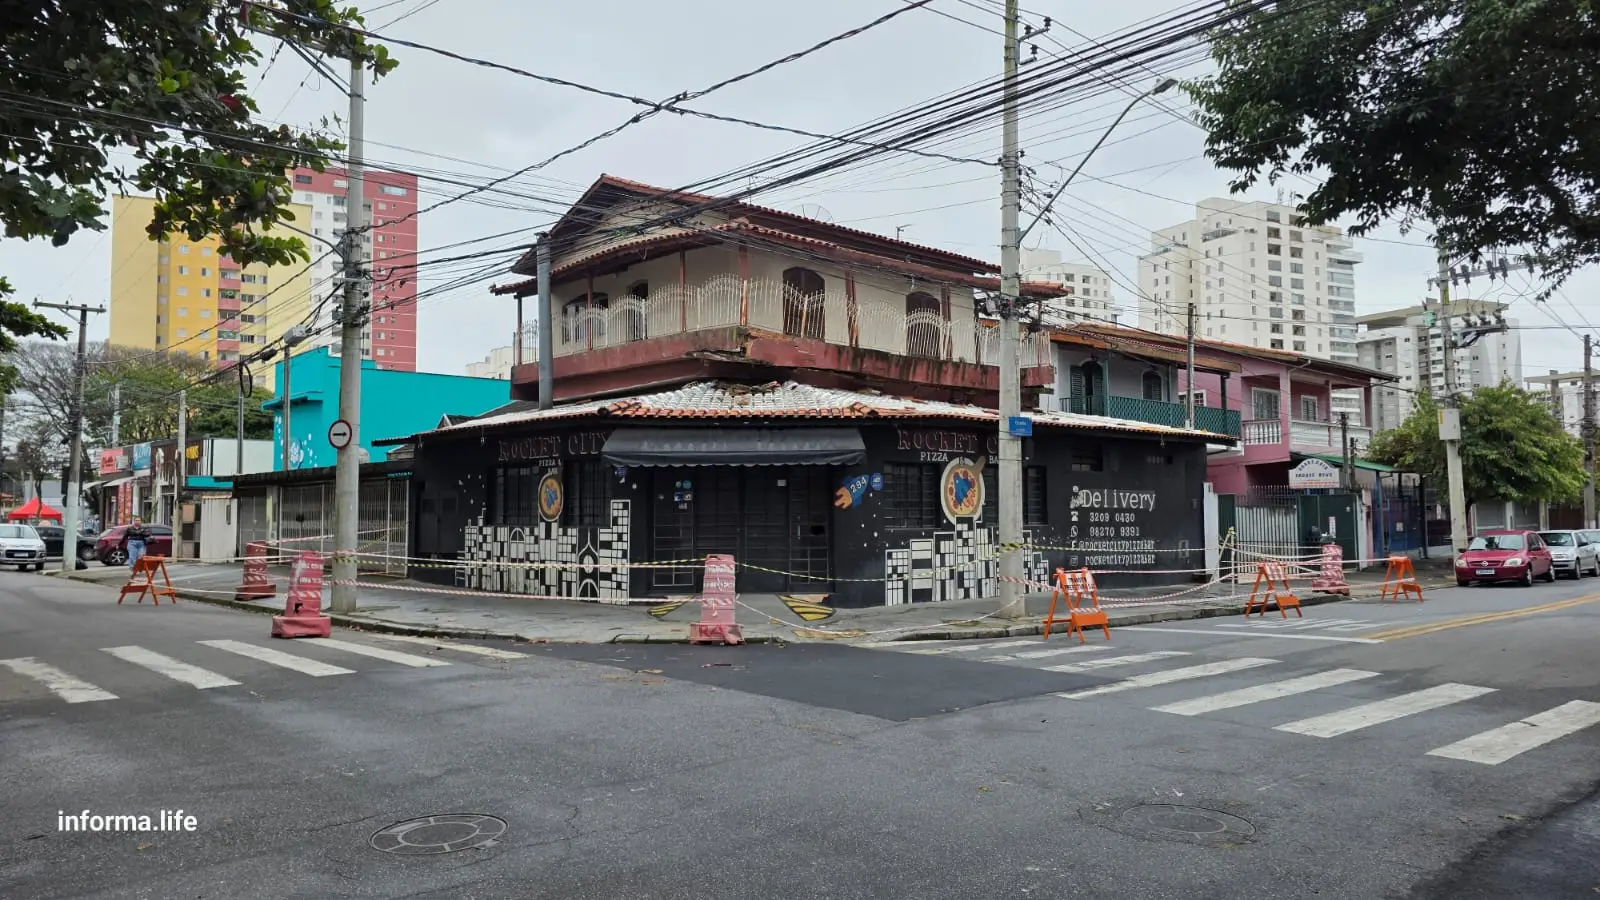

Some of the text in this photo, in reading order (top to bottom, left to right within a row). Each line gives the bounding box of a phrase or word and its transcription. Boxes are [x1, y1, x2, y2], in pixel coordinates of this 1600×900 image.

[498, 436, 562, 461] ROCKET
[897, 431, 978, 453] ROCKET
[538, 459, 556, 468] PIZZA
[920, 451, 949, 463] PIZZA
[989, 455, 999, 465] BA
[850, 476, 867, 493] 294
[1081, 489, 1156, 511] Delivery
[1089, 512, 1110, 522] 3209
